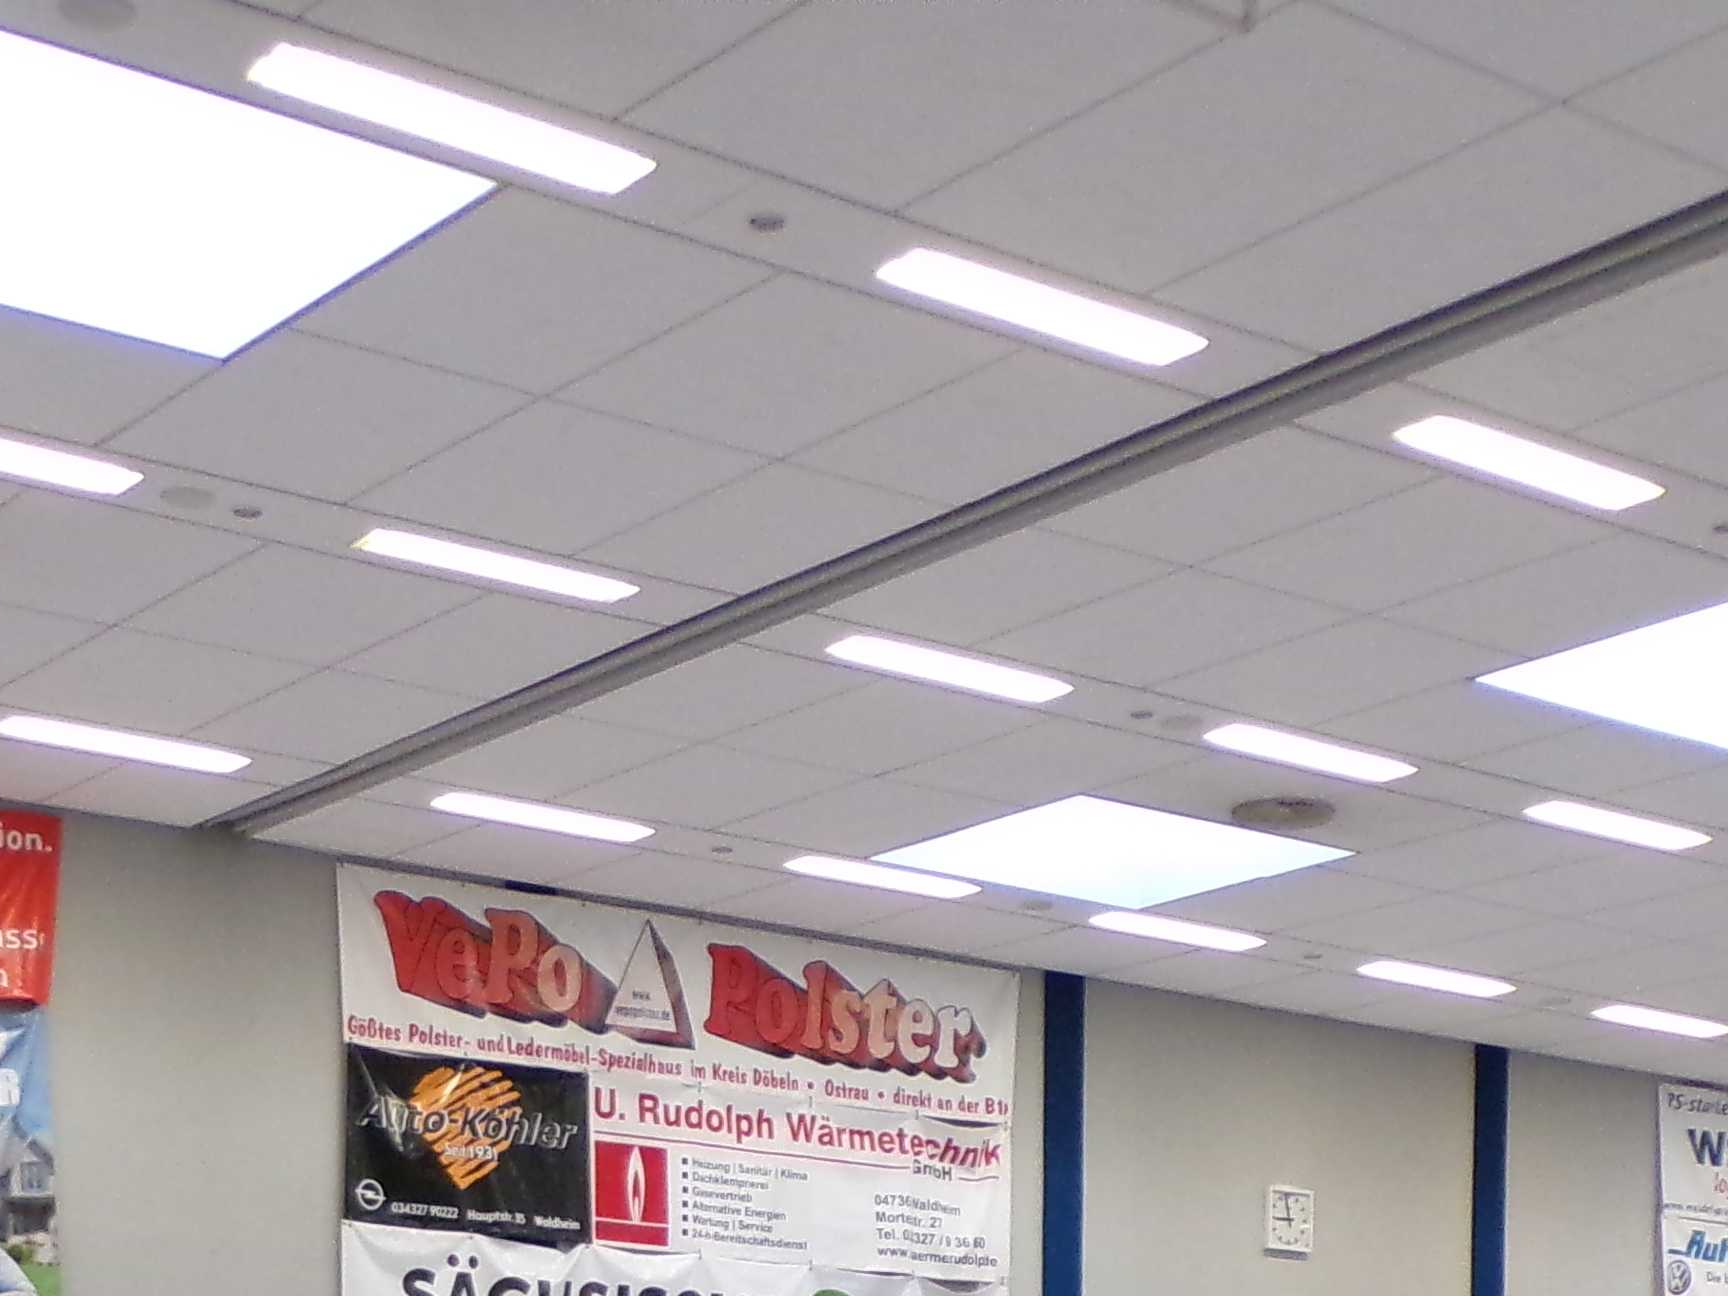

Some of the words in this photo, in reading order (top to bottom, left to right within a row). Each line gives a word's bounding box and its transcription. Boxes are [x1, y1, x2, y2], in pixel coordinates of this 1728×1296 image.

[703, 942, 982, 1080] Polster
[409, 1023, 471, 1048] Polster-
[477, 1034, 504, 1053] und
[507, 1038, 682, 1075] Ledermöbel-Spezialhaus
[690, 1060, 706, 1080] im
[711, 1062, 747, 1085] Kreis
[752, 1067, 800, 1092] Döbeln
[824, 1079, 869, 1101] Ostrau
[893, 1089, 933, 1109] direkt
[936, 1098, 952, 1111] an
[958, 1096, 980, 1114] der
[355, 1095, 578, 1149] Auto-Köhler
[593, 1086, 626, 1122] U.
[638, 1092, 774, 1145] Rudolph
[786, 1111, 1002, 1168] Wärmetechnik
[780, 1168, 809, 1181] Klima
[391, 1202, 428, 1216] 034327
[429, 1205, 459, 1219] 90222
[738, 1219, 774, 1233] Service
